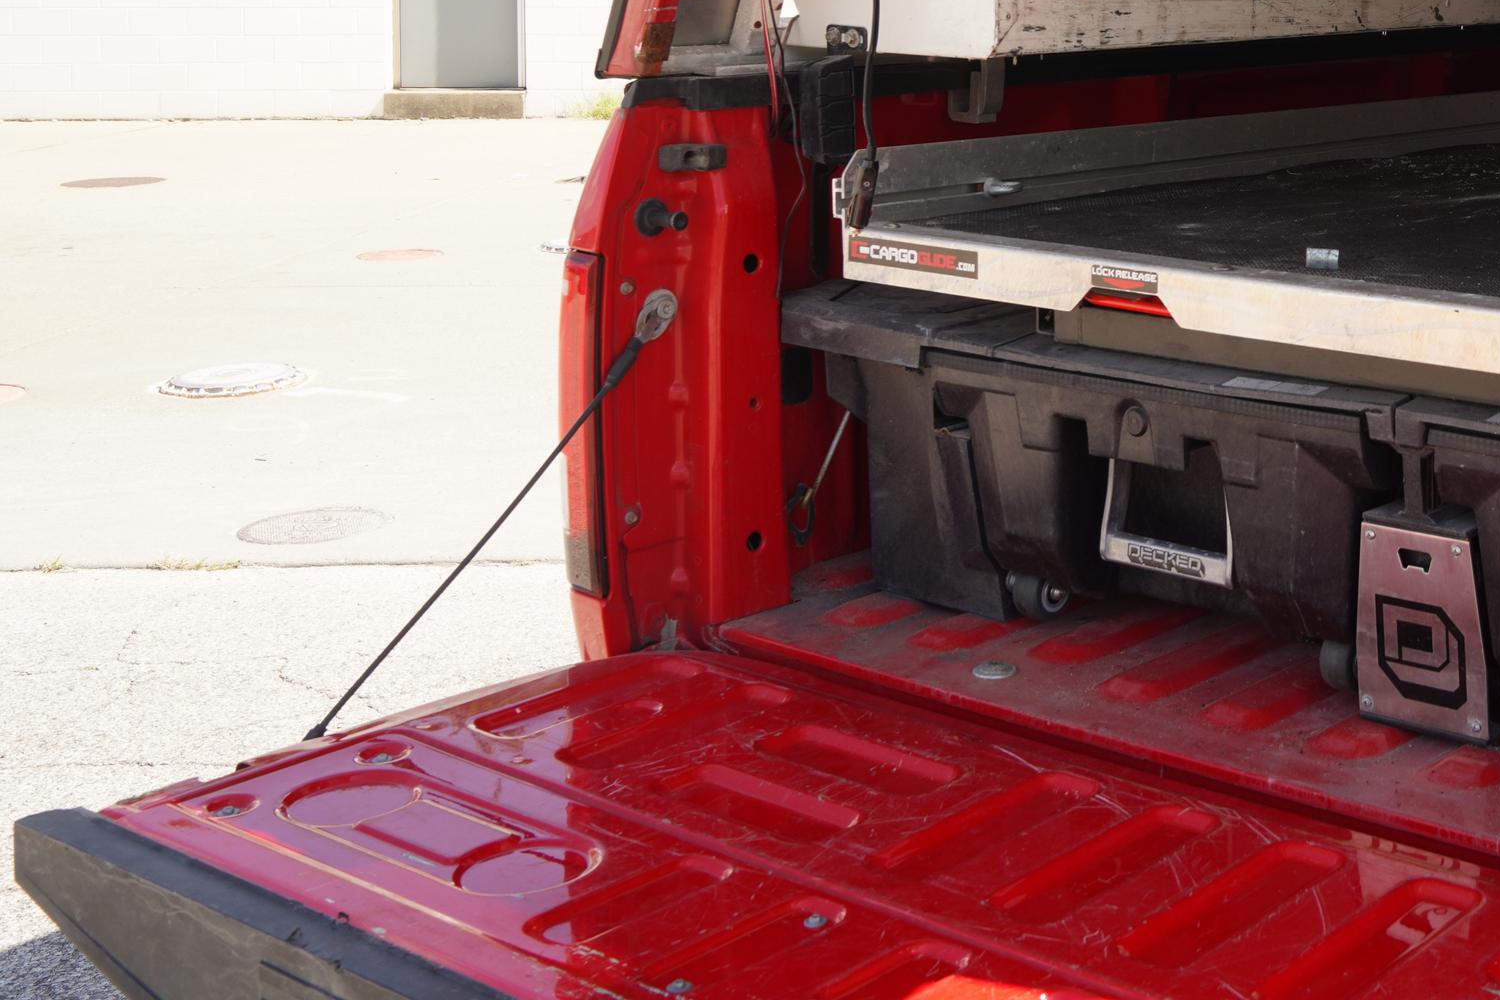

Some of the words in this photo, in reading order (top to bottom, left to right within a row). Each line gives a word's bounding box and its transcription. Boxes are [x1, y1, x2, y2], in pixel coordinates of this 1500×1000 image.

[1091, 265, 1115, 277] LOCK
[1115, 269, 1157, 283] RELEASE
[1128, 543, 1205, 577] DECKED
